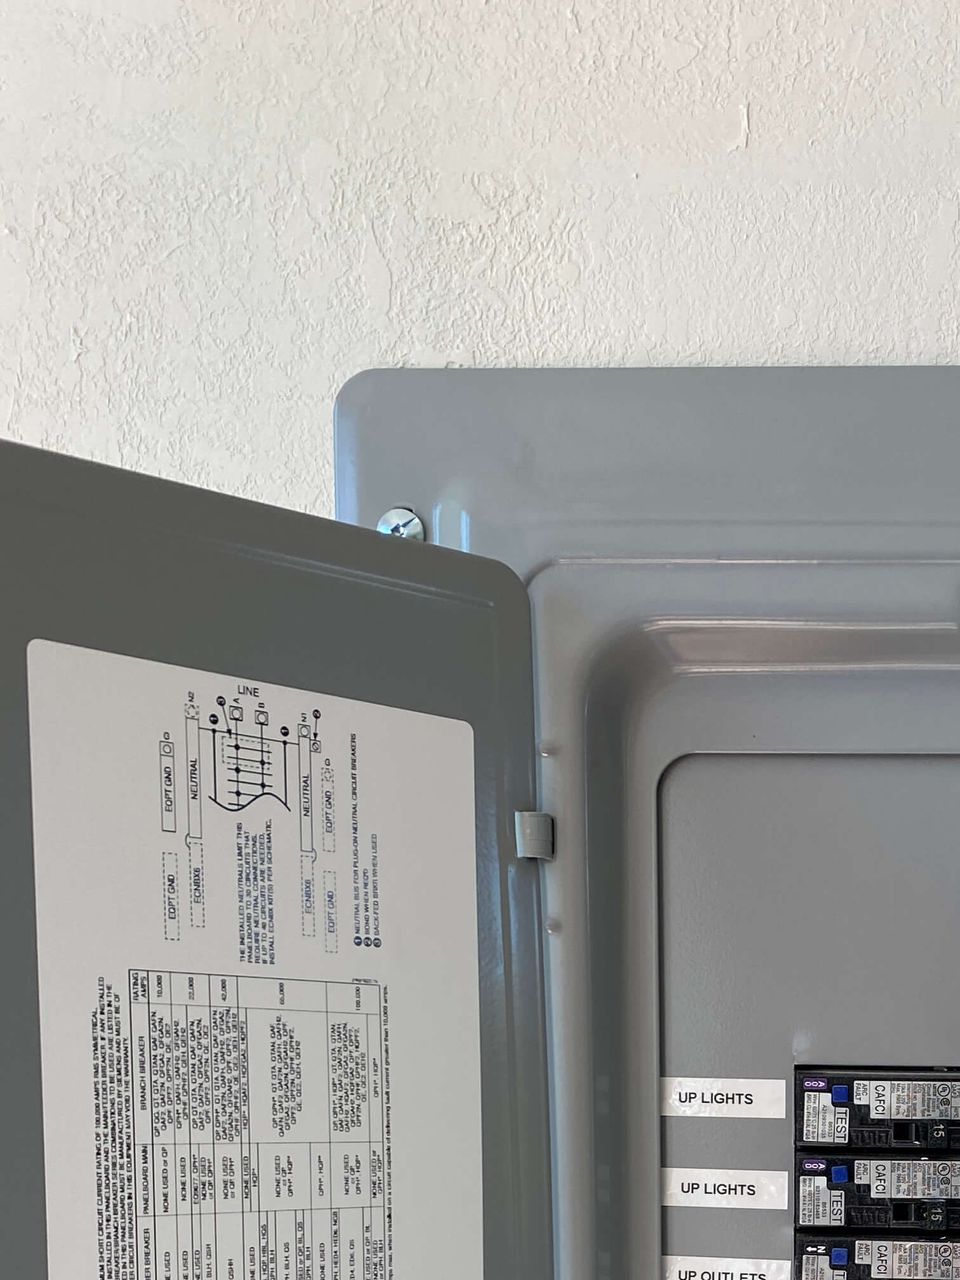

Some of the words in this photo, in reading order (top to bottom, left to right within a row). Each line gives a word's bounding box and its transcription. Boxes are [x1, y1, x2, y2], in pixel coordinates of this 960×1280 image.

[238, 685, 259, 698] LINE
[302, 774, 310, 817] NEUTRAL
[167, 874, 175, 894] GND
[678, 1092, 697, 1103] UP
[702, 1093, 753, 1105] LIGHTS
[875, 1085, 885, 1114] CAFCI
[836, 1109, 847, 1142] TEST
[934, 1124, 944, 1138] 15
[681, 1183, 700, 1193] UP
[704, 1184, 756, 1195] LIGHTS
[876, 1165, 886, 1194] CAFCI
[832, 1193, 843, 1224] TEST
[931, 1207, 942, 1221] 15
[877, 1245, 887, 1275] CAFCI
[678, 1270, 697, 1280] UP
